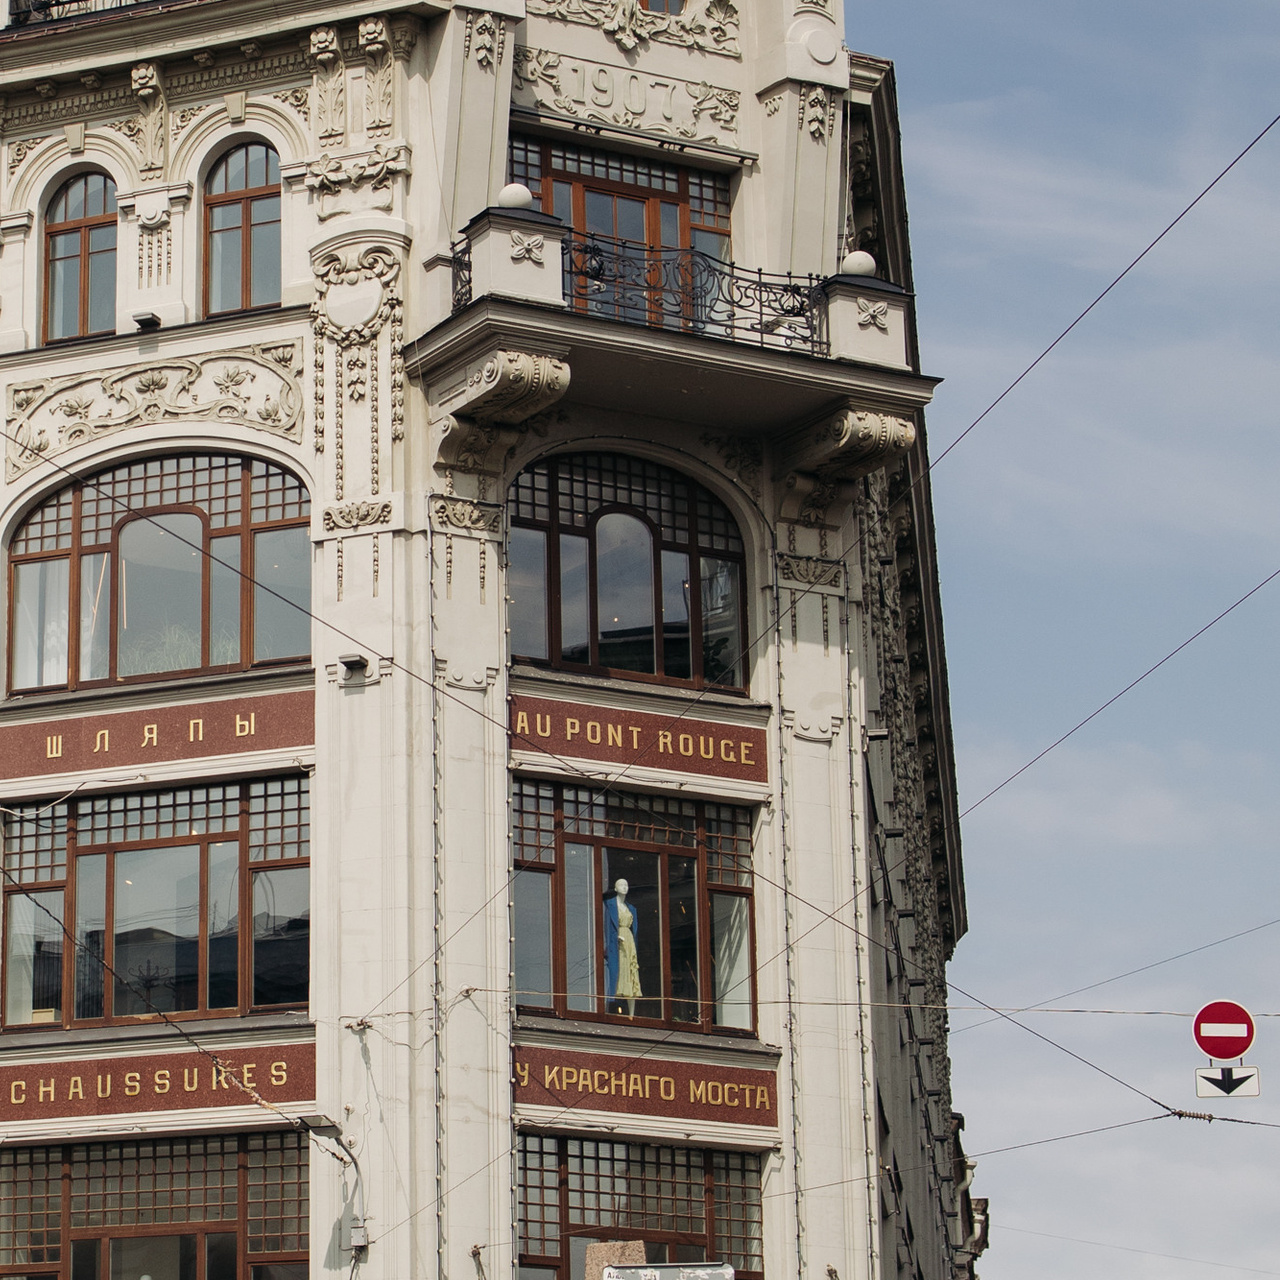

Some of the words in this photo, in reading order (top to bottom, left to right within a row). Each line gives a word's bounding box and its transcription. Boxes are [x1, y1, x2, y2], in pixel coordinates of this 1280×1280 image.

[46, 713, 255, 759] ШЛЯПЫ
[516, 711, 551, 738] AU
[566, 718, 642, 750] PONT
[659, 730, 756, 766] ROUGE
[10, 1061, 288, 1105] CHAUSSURES
[516, 1062, 529, 1087] У
[544, 1065, 675, 1101] КРАСНАГО
[689, 1079, 771, 1110] МОСТА
